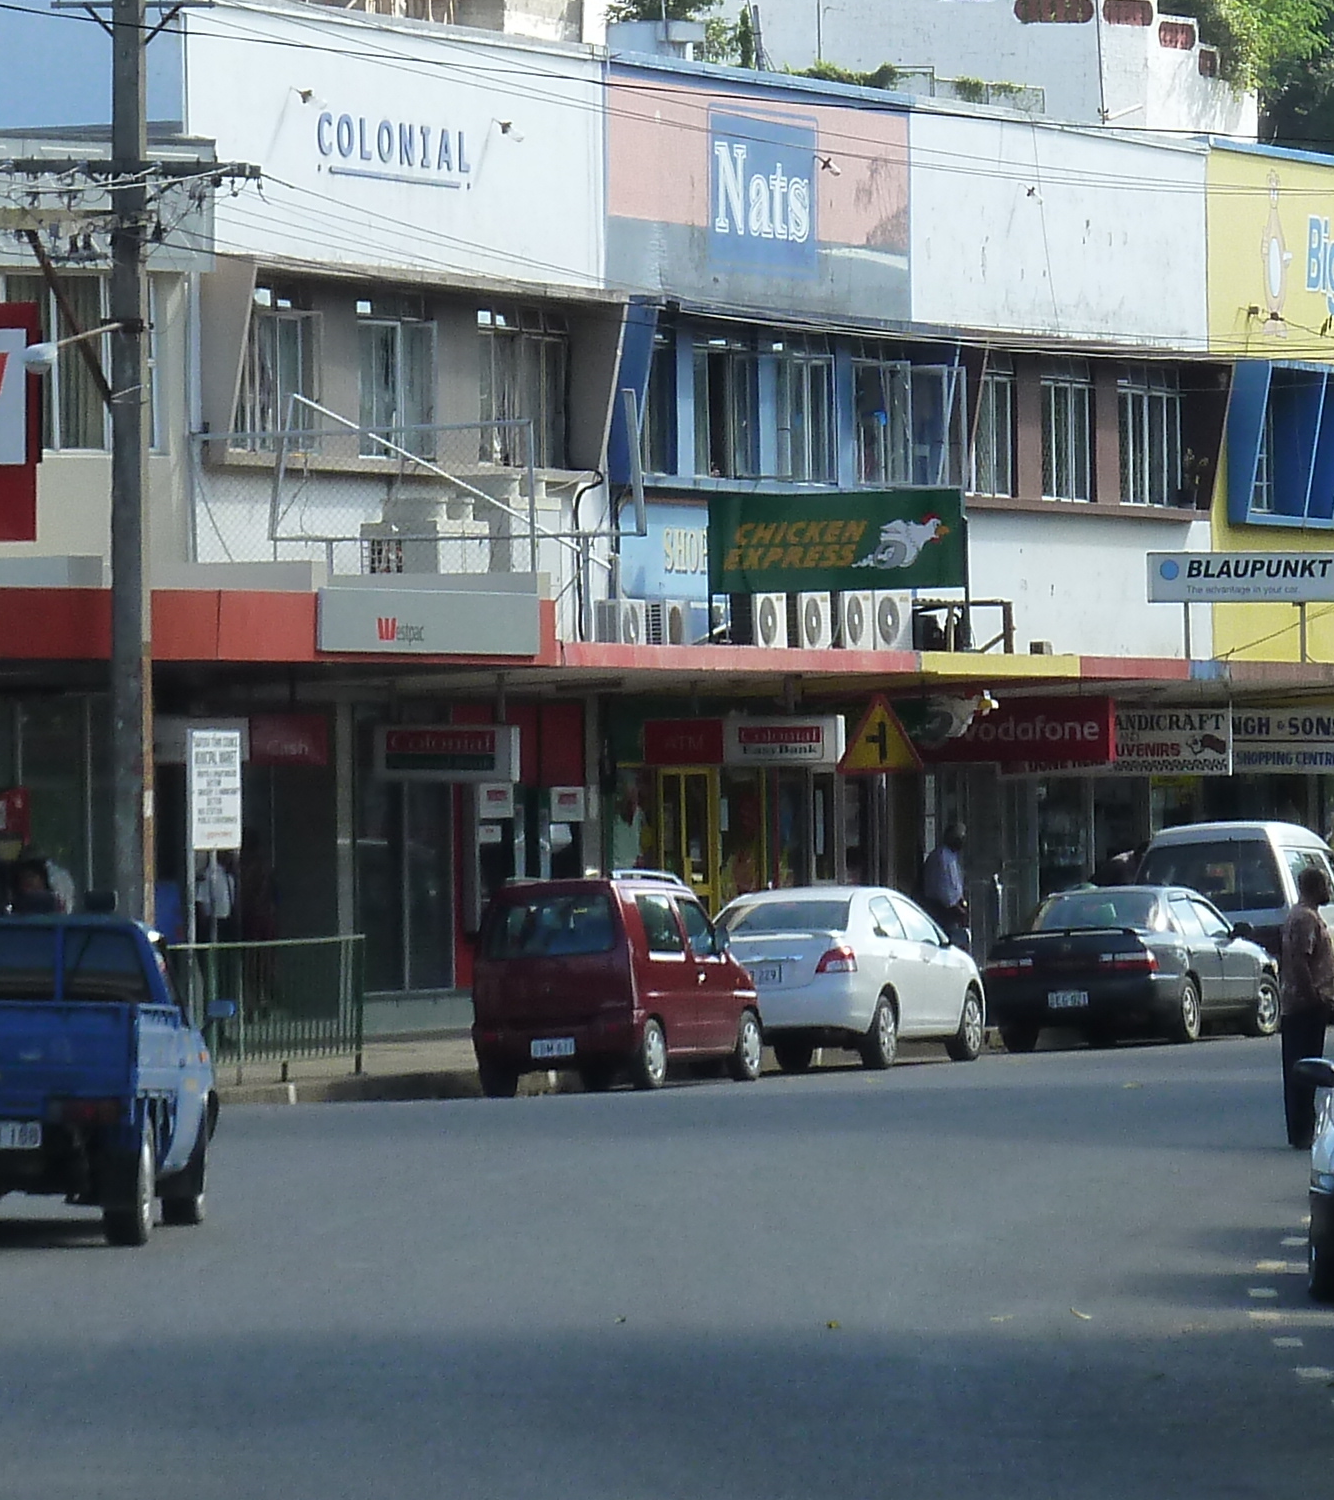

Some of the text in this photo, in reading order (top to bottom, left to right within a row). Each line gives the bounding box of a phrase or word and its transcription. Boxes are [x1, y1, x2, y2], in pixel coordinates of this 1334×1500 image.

[317, 112, 471, 173] COLONIAL
[714, 141, 810, 243] Nats
[734, 519, 867, 545] CHICKEN
[723, 544, 857, 571] EXPRESS
[1187, 559, 1332, 578] BLAUPUNKT
[1187, 584, 1203, 594] The
[1205, 585, 1251, 596] advantage
[1253, 585, 1262, 594] in
[1263, 586, 1282, 596] your
